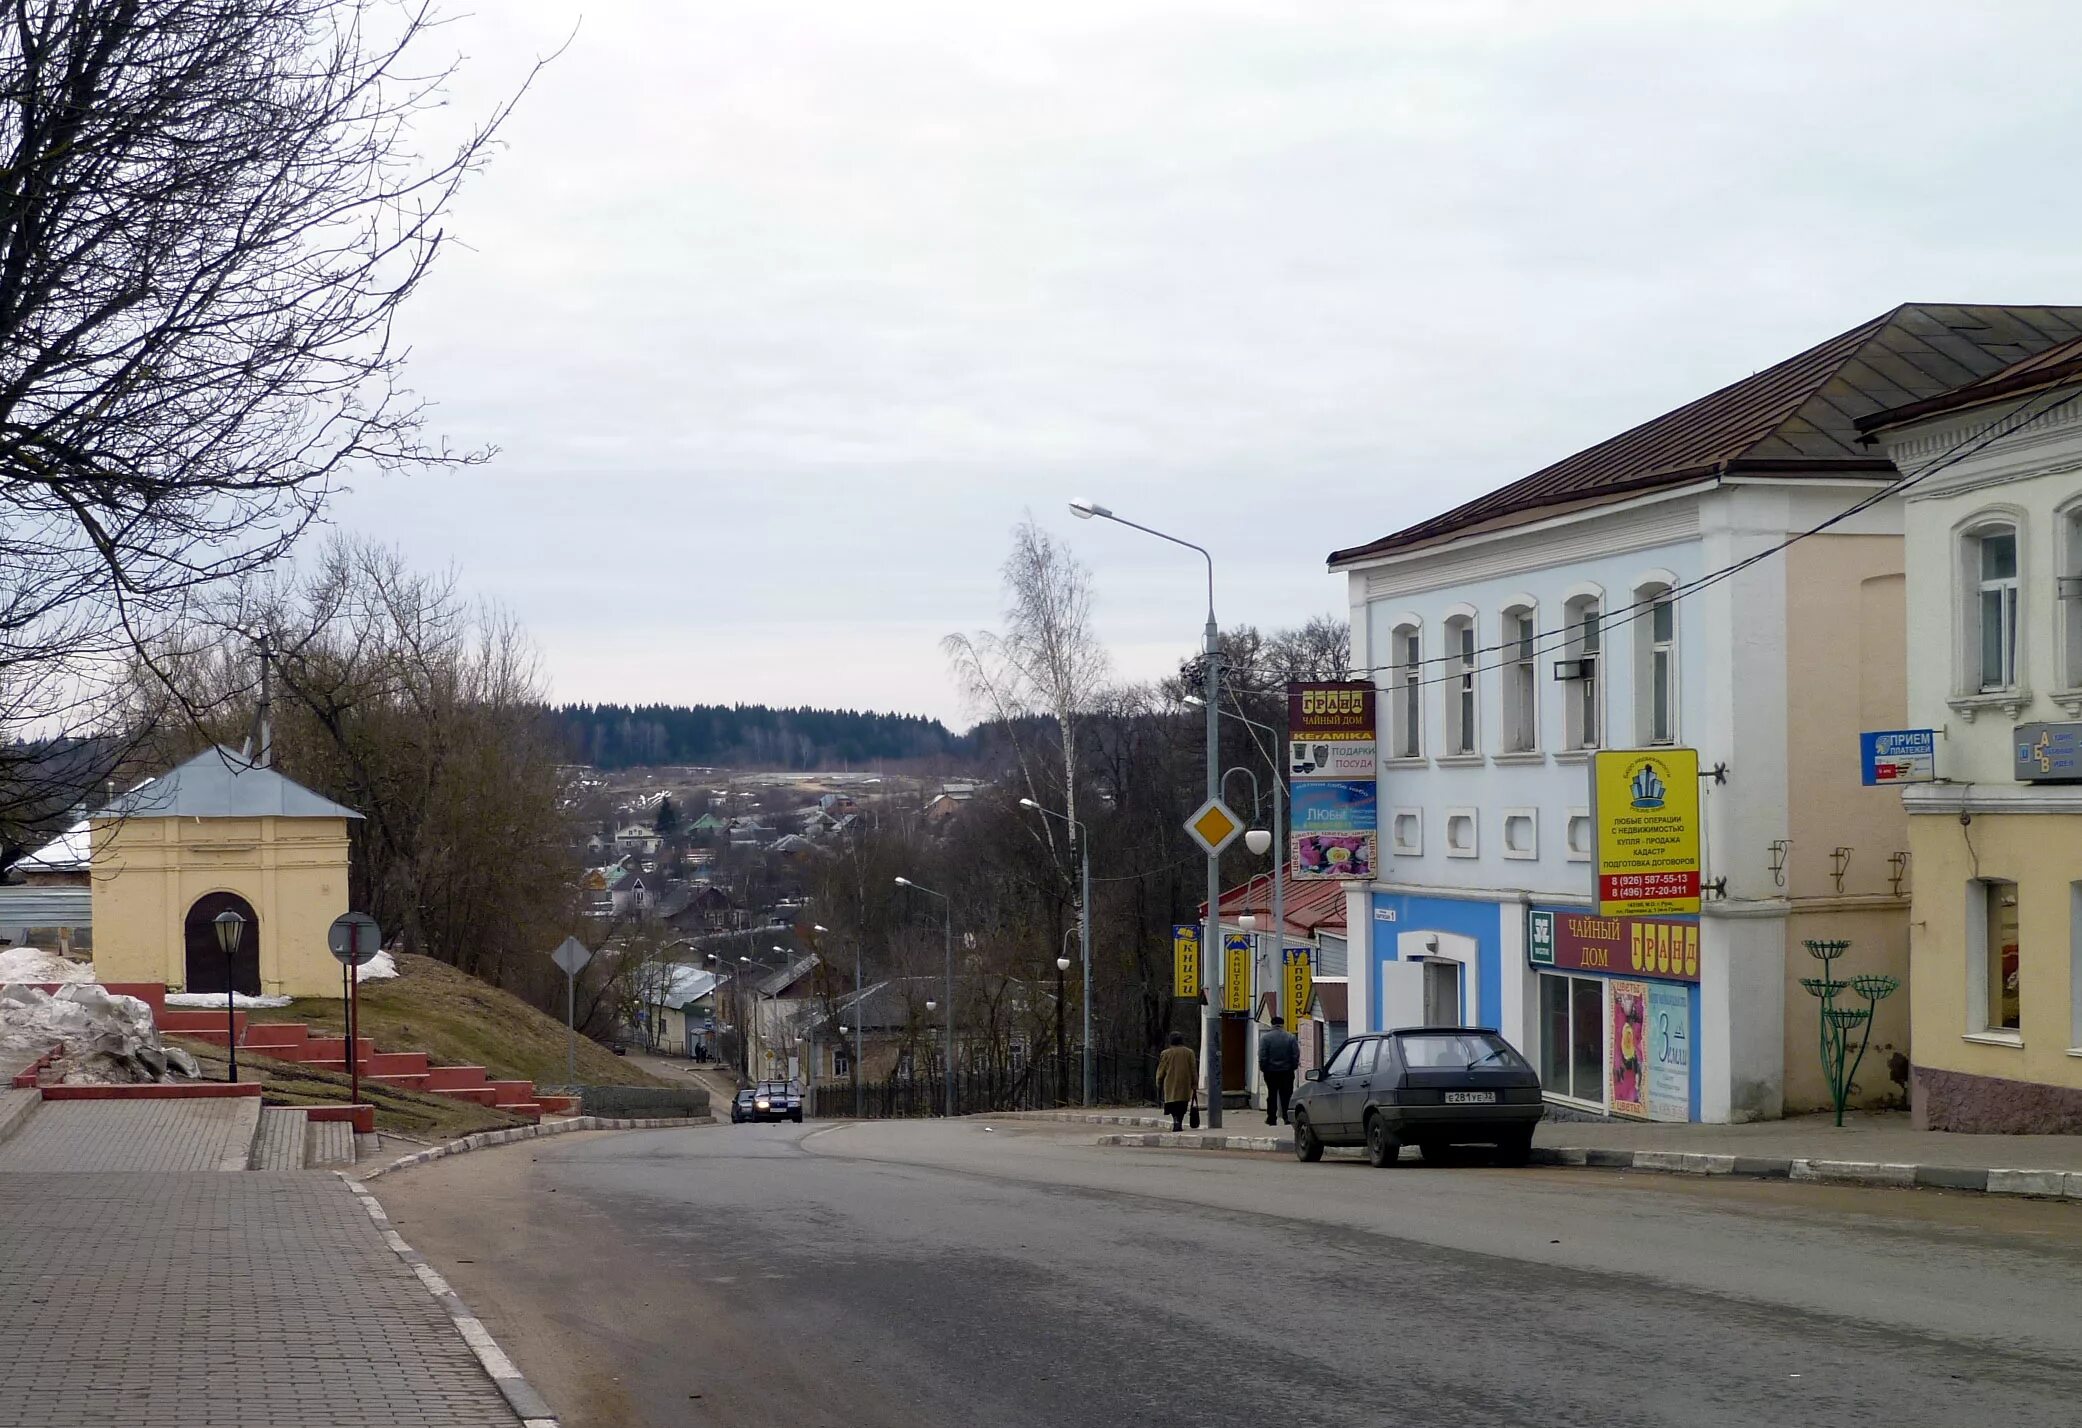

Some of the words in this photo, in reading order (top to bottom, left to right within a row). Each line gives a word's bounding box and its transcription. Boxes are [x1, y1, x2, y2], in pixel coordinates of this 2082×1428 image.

[1303, 699, 1362, 710] ГРАНД
[1303, 714, 1341, 726] ЧАЙНЫЙ
[1343, 715, 1363, 727] ДОМ
[1890, 733, 1931, 746] ПРИЕМ
[1332, 746, 1375, 757] ПОДАРКИ
[1890, 745, 1931, 755] ПЛАТЕЖЕЙ
[1336, 760, 1373, 769] ПОСУДА
[1614, 817, 1642, 825] ЛЮБЫЕ
[1643, 815, 1682, 824] ОПЕРАЦИИ
[1618, 825, 1685, 835] НЕДВИЖИМОСТЬЮ
[1617, 838, 1641, 846] КУПЛЯ
[1646, 836, 1681, 845] ПРОДАЖА
[1633, 848, 1666, 856] КАДАСТР
[1603, 859, 1650, 868] ПОДГОТОВКА
[1652, 857, 1695, 867] ДОГОВОРОВ
[1611, 876, 1618, 886] 8
[1619, 875, 1642, 887] (926)
[1644, 874, 1688, 884] 587-55-13
[1611, 888, 1618, 897] 8
[1619, 886, 1643, 898] (496)
[1644, 885, 1687, 896] 27-20-911
[1568, 916, 1621, 941] ЧАЙНЫЙ
[1633, 936, 1697, 961] ГРАНД
[1580, 948, 1609, 967] ДОМ
[1232, 950, 1241, 1009] КАНЦТОВАРЫ
[1294, 967, 1304, 1034] ПРОДУК
